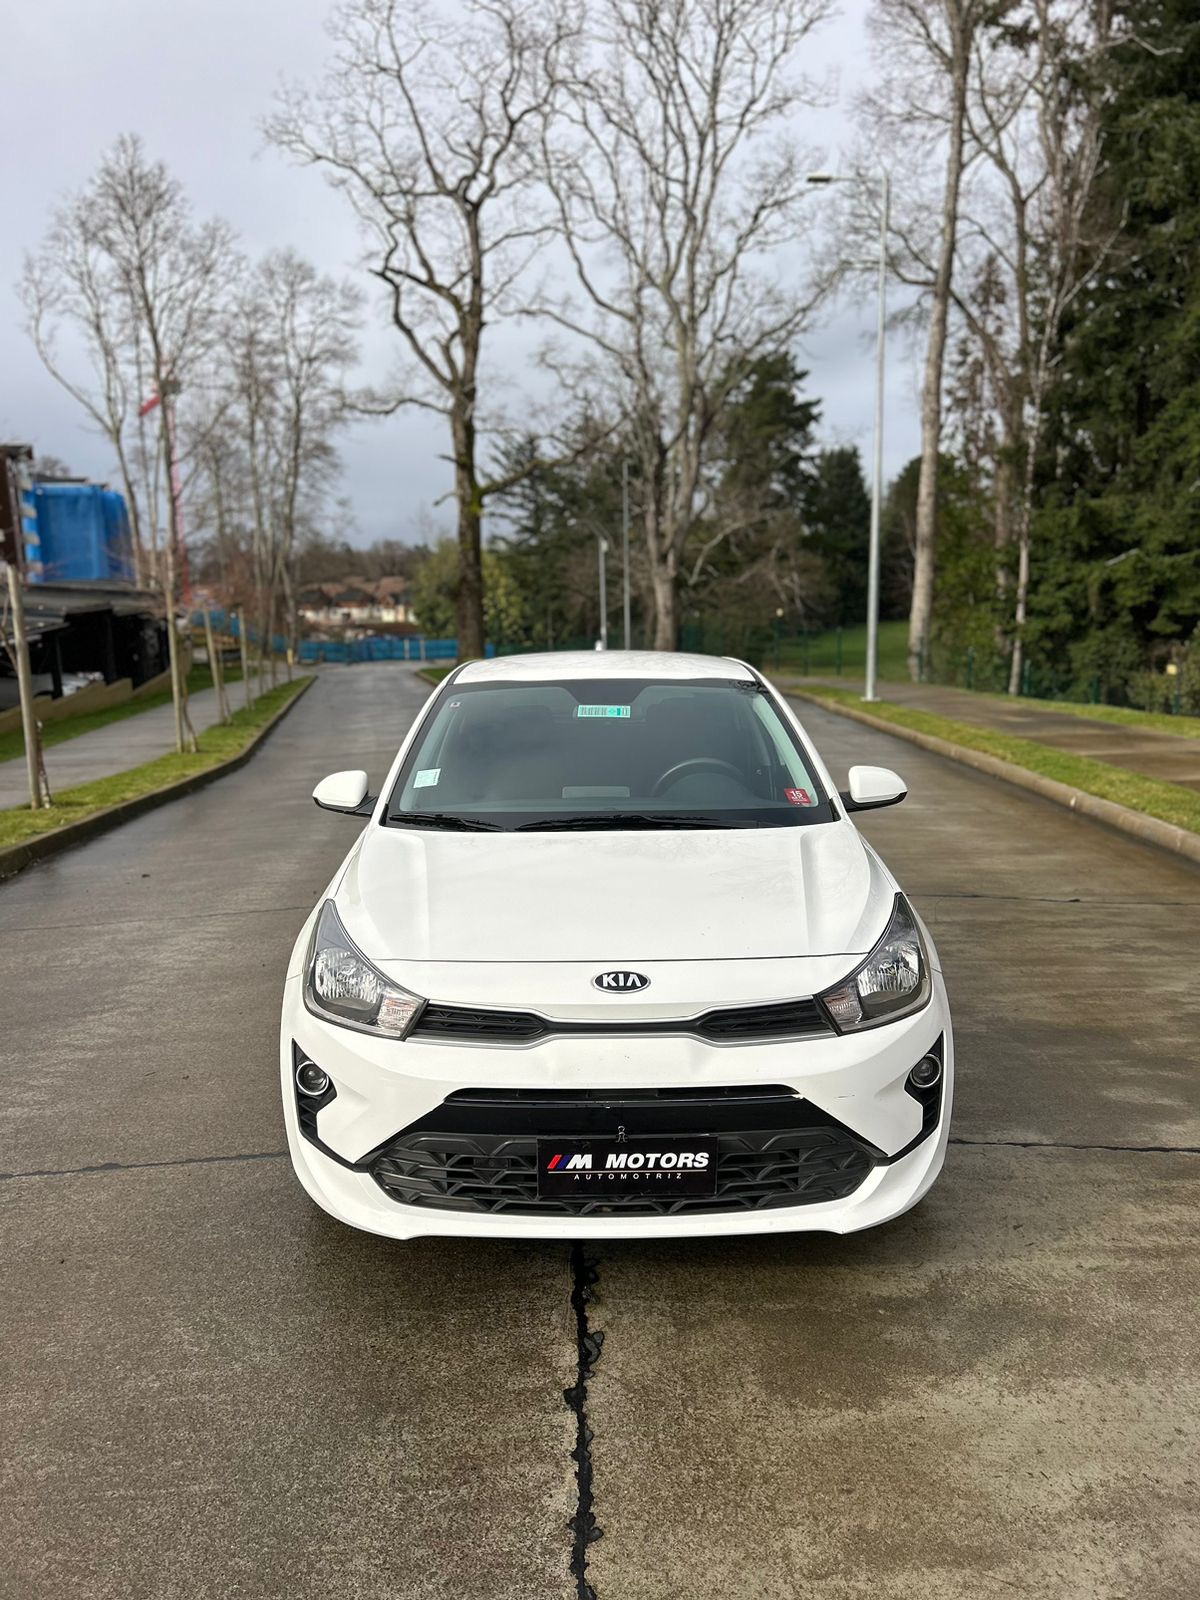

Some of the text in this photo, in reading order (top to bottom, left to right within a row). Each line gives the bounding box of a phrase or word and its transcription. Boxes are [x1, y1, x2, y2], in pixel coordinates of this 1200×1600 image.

[602, 973, 642, 987] KIA
[605, 1152, 709, 1169] MOTORS
[573, 1172, 682, 1181] AUTOMOTRIZ
